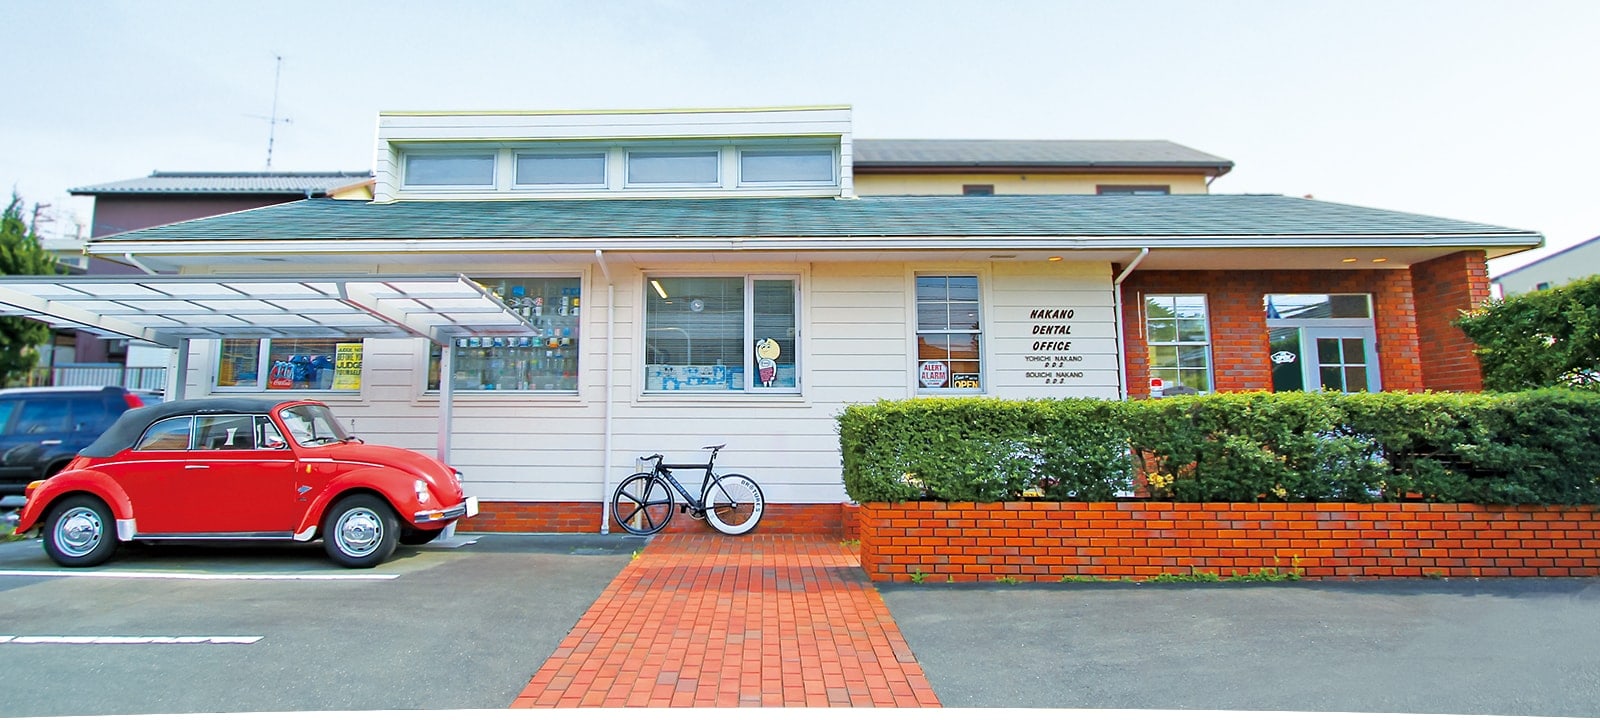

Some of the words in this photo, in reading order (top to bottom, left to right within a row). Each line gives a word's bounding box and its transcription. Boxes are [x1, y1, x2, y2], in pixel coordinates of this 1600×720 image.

[1030, 309, 1074, 319] NAKANO
[1032, 325, 1071, 335] DENTAL
[1032, 341, 1071, 350] OFFICE
[336, 361, 363, 369] JUDGE
[954, 380, 979, 388] OPEN
